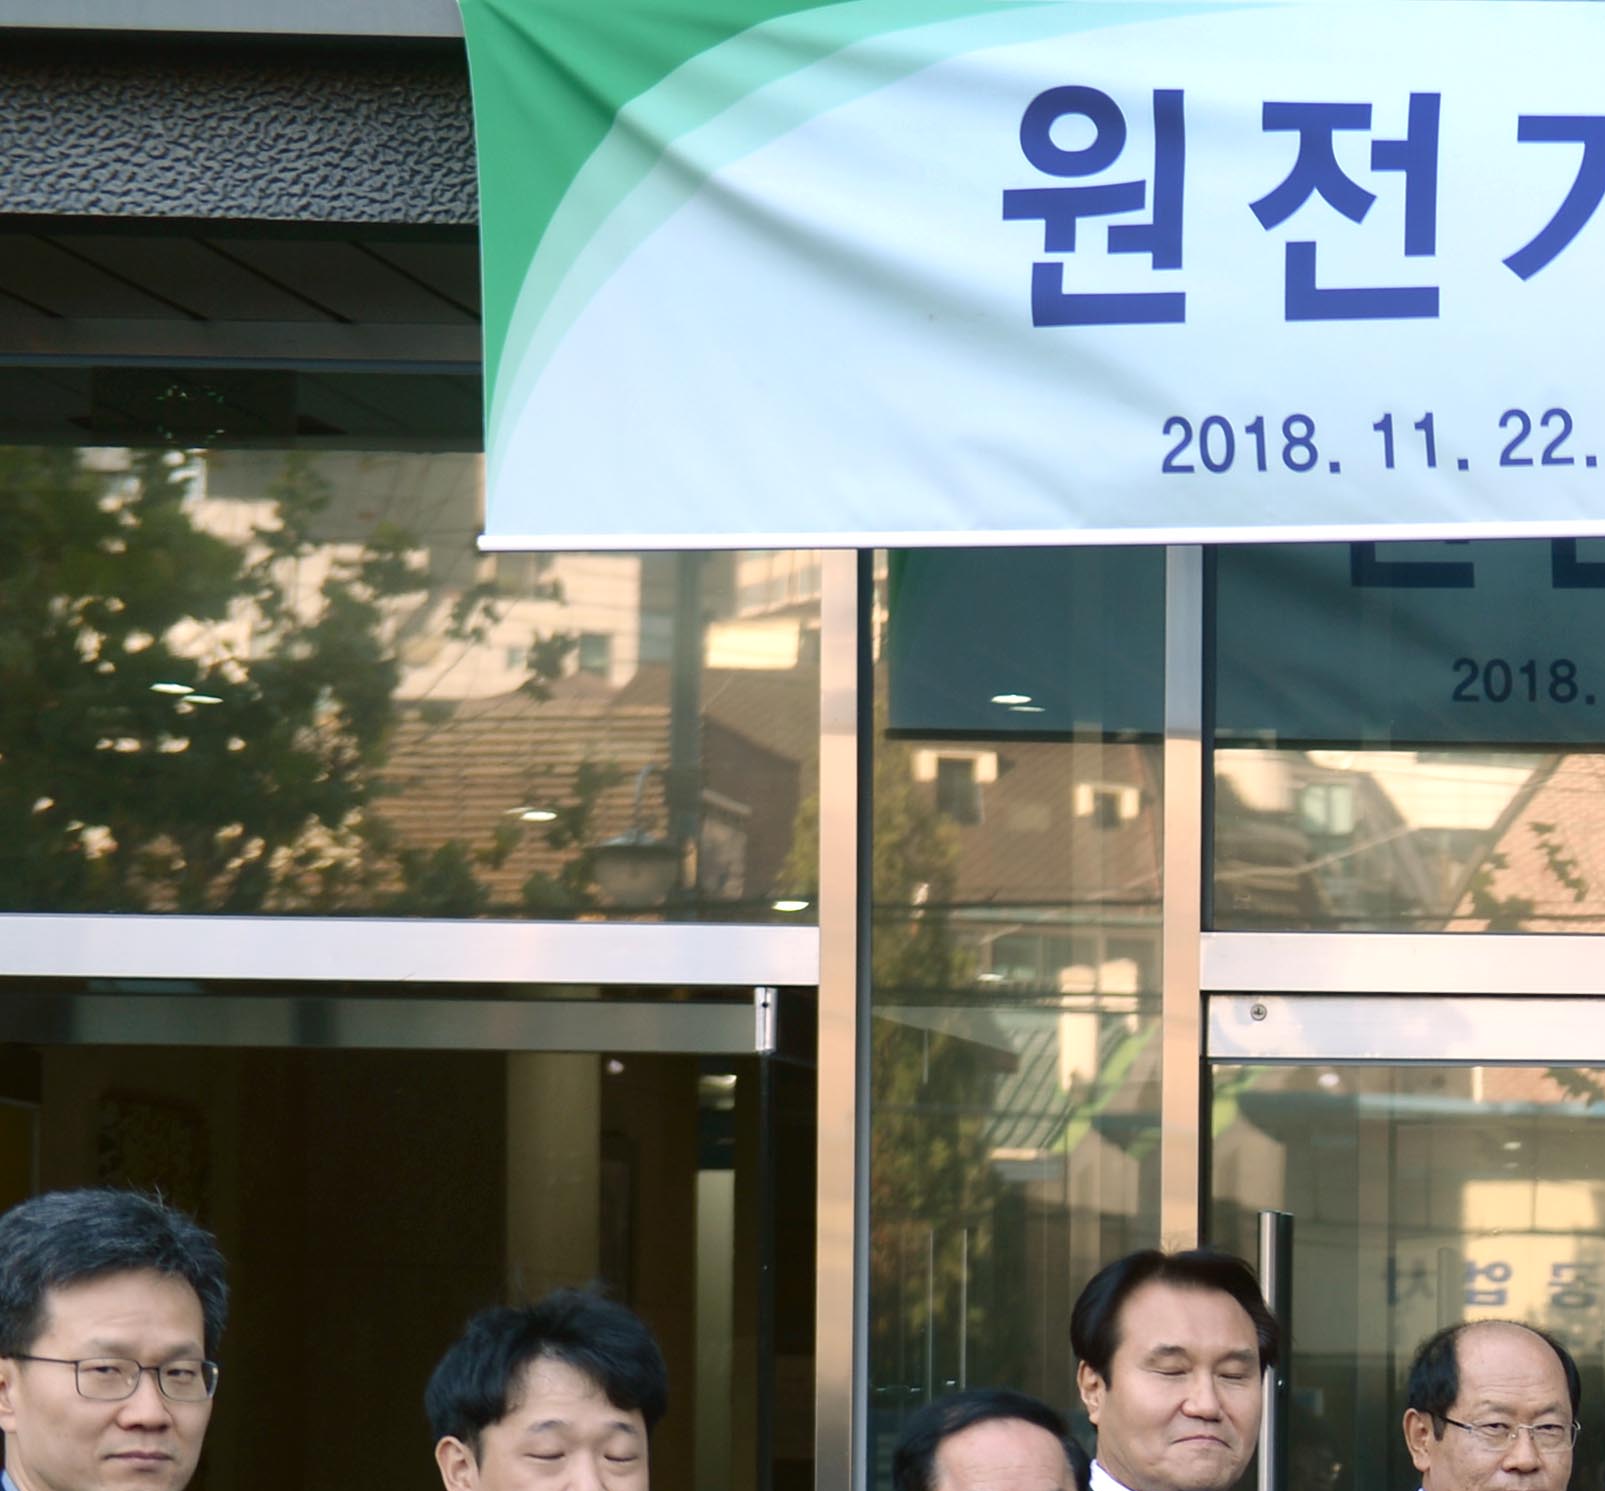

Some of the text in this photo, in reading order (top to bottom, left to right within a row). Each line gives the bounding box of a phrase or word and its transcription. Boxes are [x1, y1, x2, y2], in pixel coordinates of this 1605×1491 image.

[1162, 414, 1342, 476] 2018.
[1373, 413, 1471, 473] 11.
[1499, 408, 1599, 469] 22.
[1452, 657, 1595, 704] 2018.
